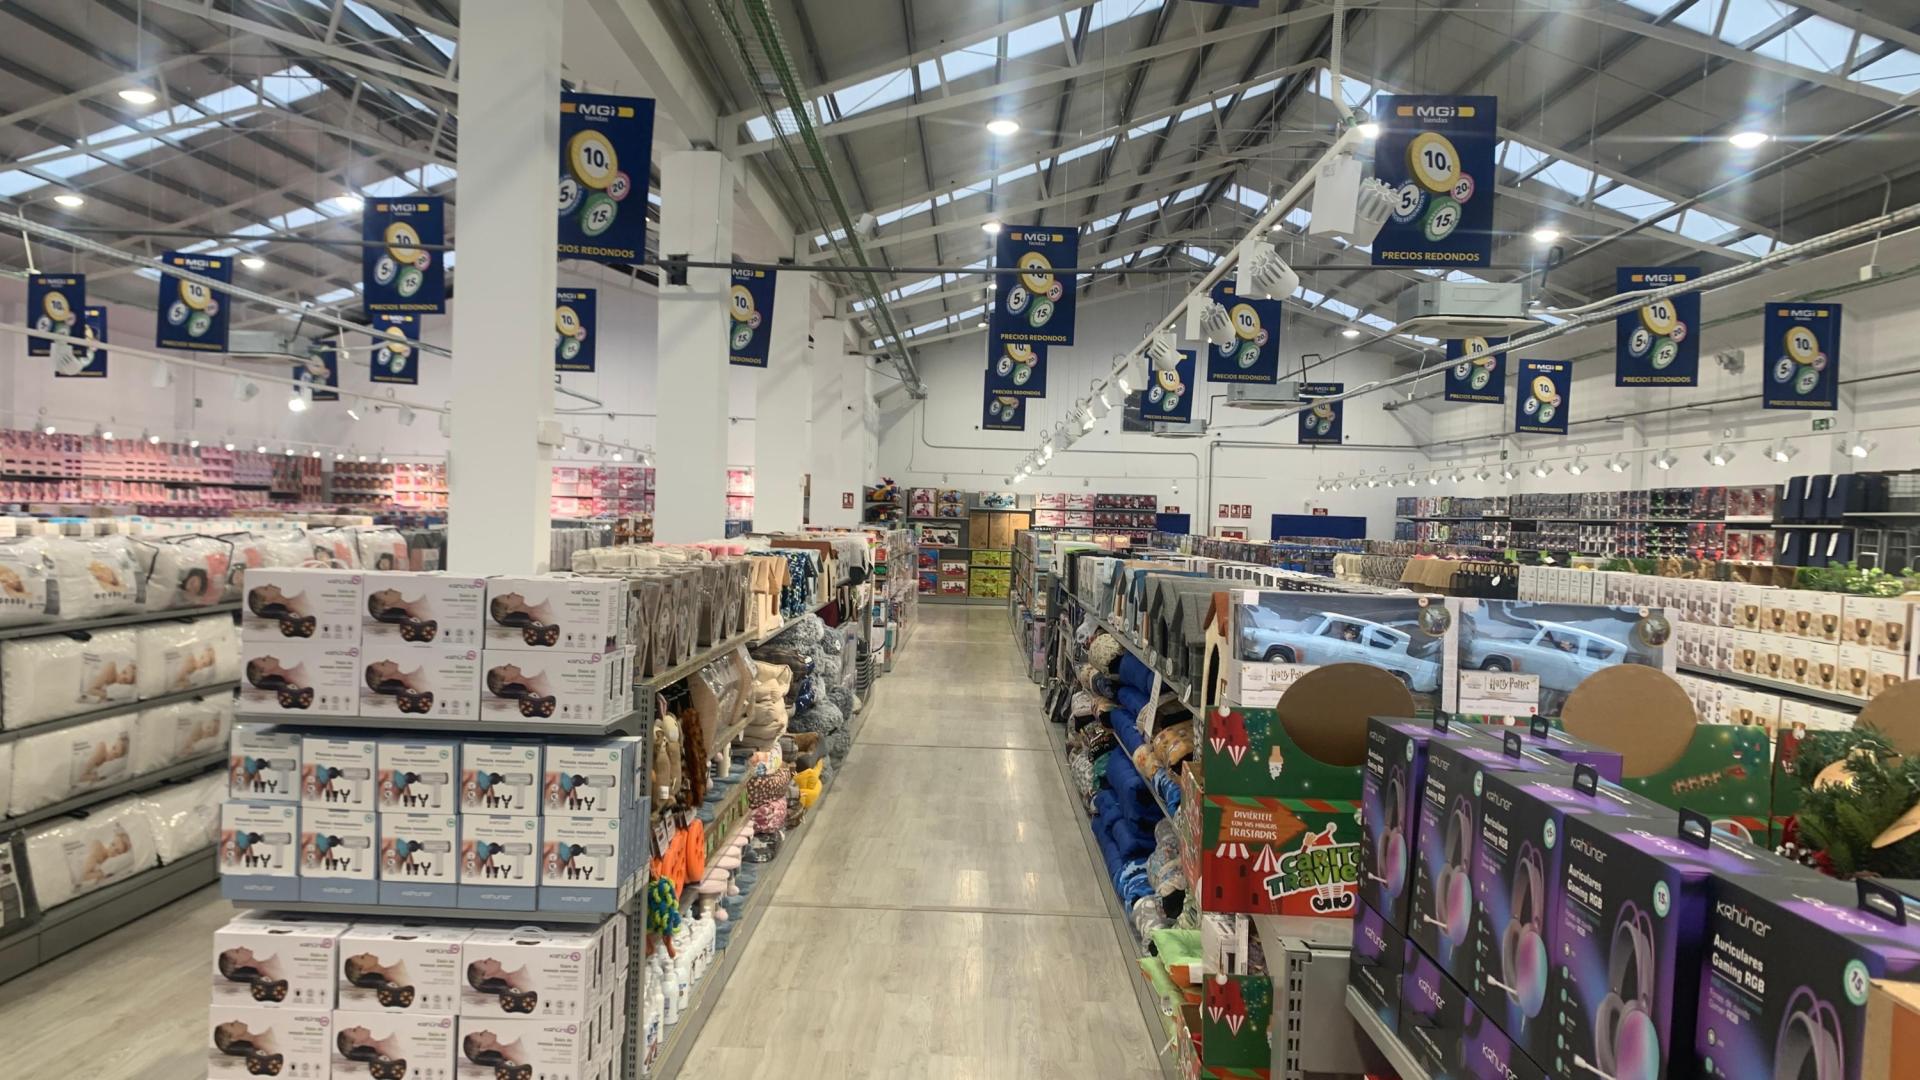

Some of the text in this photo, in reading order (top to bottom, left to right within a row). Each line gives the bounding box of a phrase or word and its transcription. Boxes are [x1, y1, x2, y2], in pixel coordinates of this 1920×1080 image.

[578, 103, 616, 117] MGi
[1417, 106, 1455, 117] MGi
[581, 245, 636, 258] REDONDOS
[1382, 251, 1480, 262] PRECIOS REDONDOS
[1645, 274, 1673, 282] MGi
[1029, 334, 1066, 342] REDONDOS
[1489, 675, 1509, 690] Harry
[1509, 676, 1530, 691] Potter
[1484, 813, 1508, 836] Auriculares
[1230, 828, 1278, 840] TRASTADAS
[1483, 826, 1508, 850] Gaming RGB
[1568, 864, 1602, 892] Auriculares
[1567, 879, 1603, 910] Gaming RGB
[1713, 933, 1763, 972] Auriculares
[1712, 952, 1765, 994] Gaming RGB
